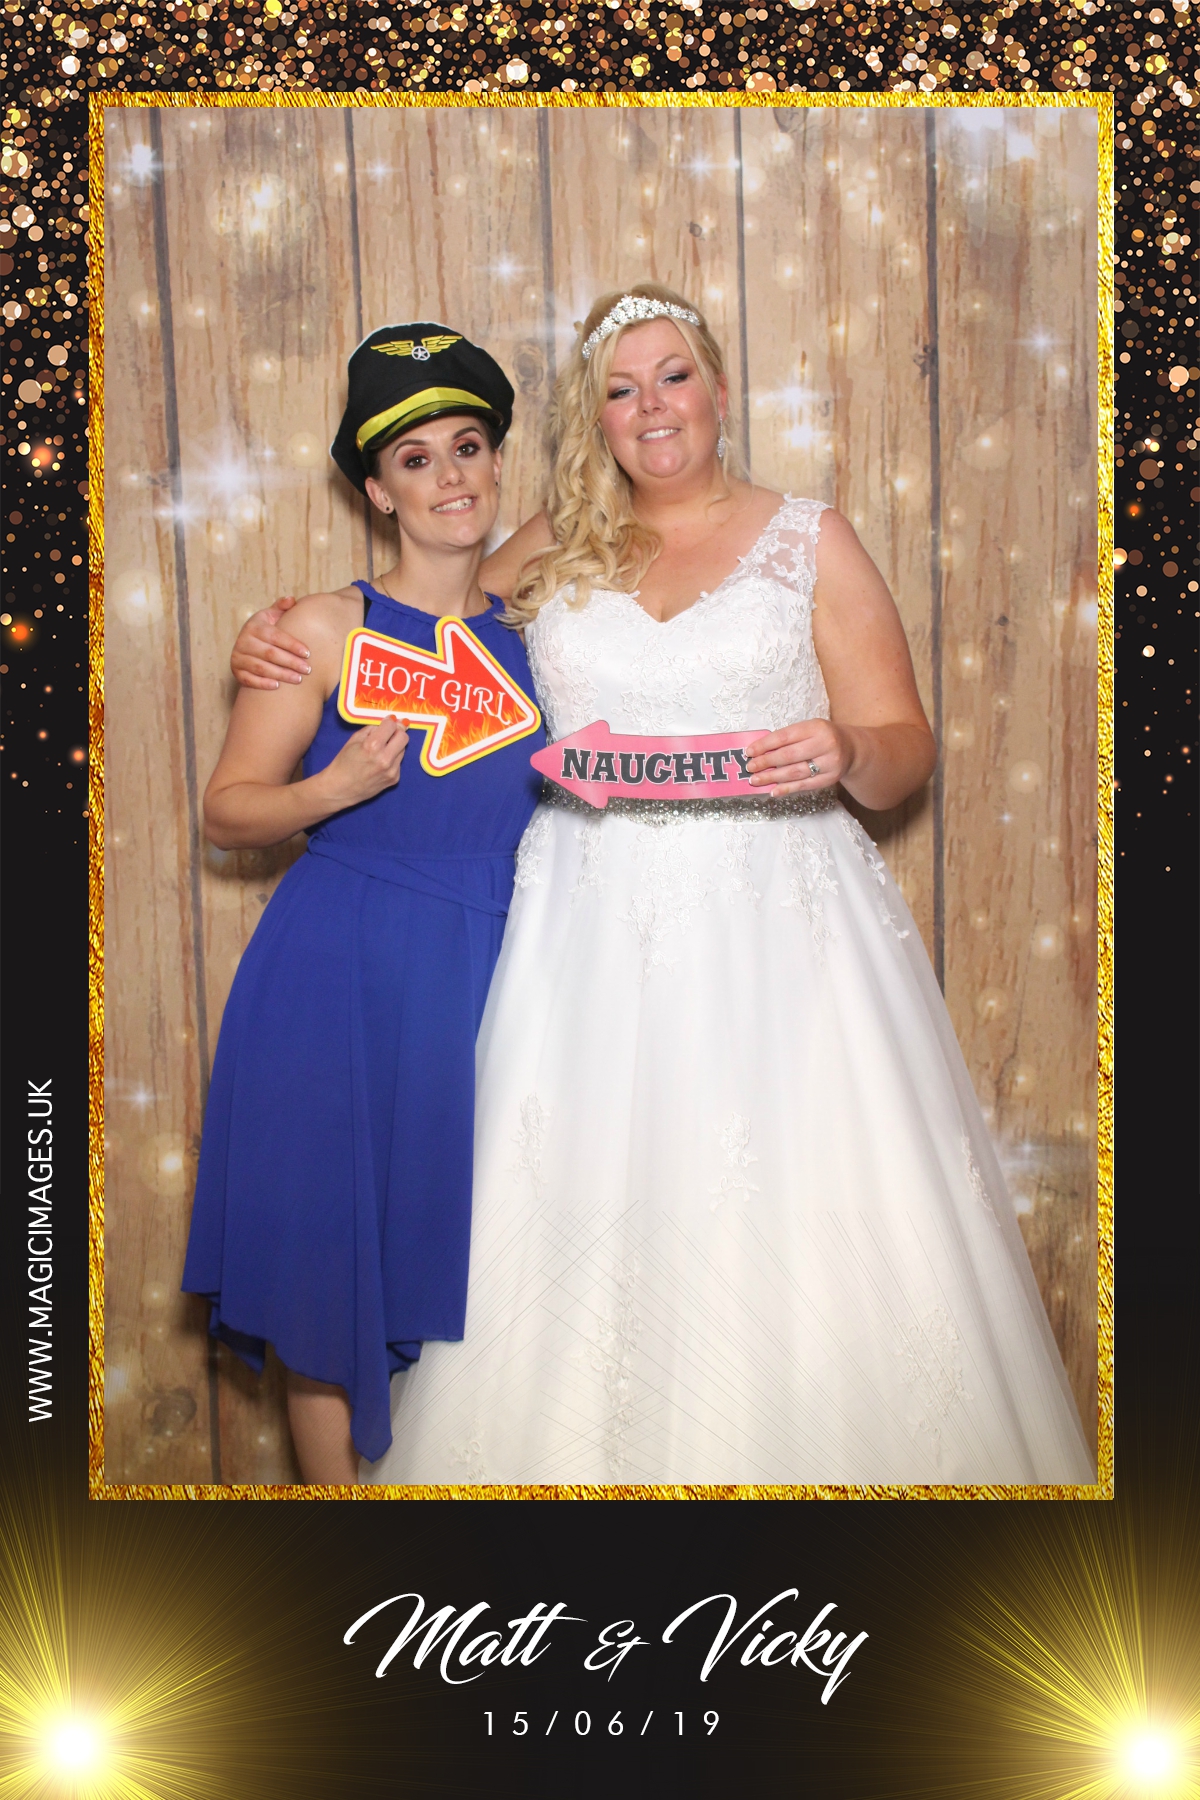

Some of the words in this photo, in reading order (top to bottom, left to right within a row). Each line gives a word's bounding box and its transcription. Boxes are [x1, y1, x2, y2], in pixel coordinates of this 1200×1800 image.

[359, 658, 436, 700] HOT
[440, 679, 511, 726] GIRL
[560, 747, 751, 784] NAUGHTY
